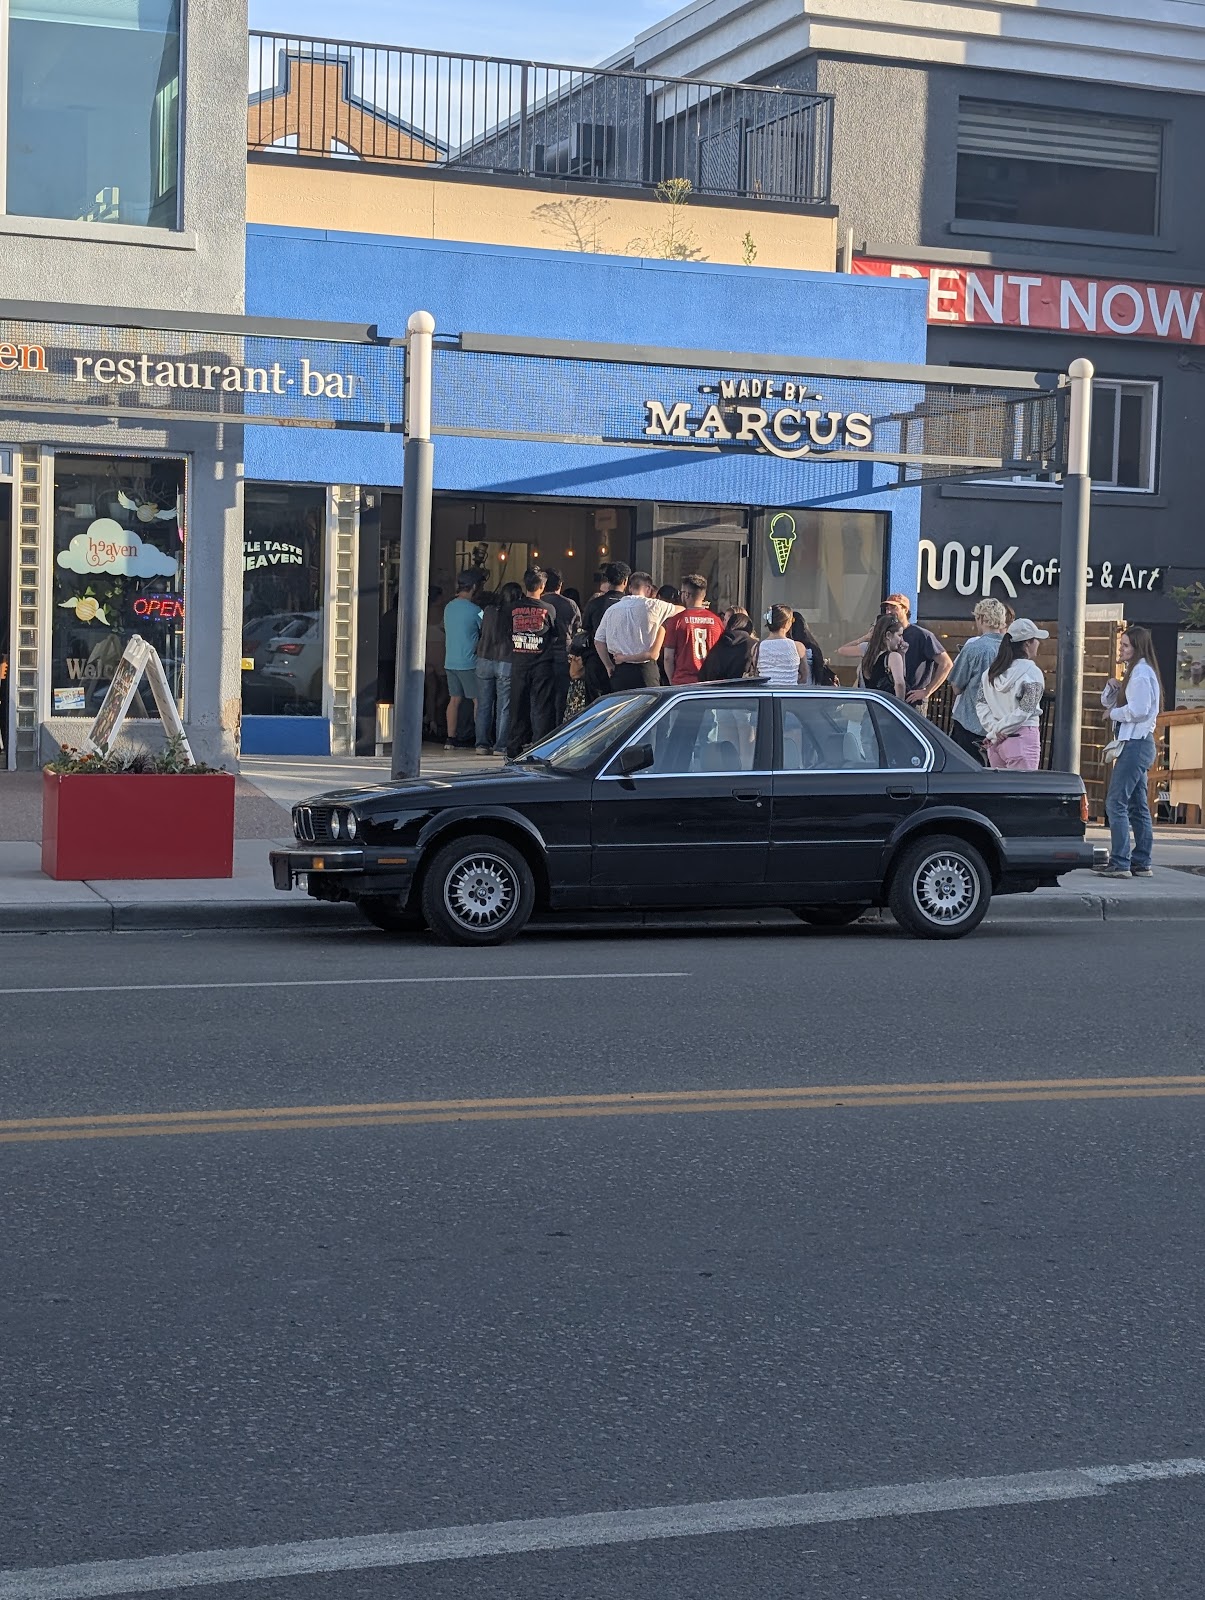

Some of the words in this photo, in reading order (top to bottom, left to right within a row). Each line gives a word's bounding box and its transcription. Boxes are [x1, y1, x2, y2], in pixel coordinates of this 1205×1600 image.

[890, 265, 1041, 326] ENT
[1059, 279, 1203, 340] NOW
[0, 342, 49, 372] en
[721, 379, 774, 399] MADE
[785, 382, 807, 404] BY
[645, 401, 873, 459] MARCUS
[264, 540, 303, 556] TASTE
[1020, 558, 1094, 587] Cofe
[1100, 561, 1113, 588] &
[1118, 563, 1160, 592] Art
[133, 598, 185, 617] OPEN
[694, 627, 708, 660] 8
[66, 658, 117, 680] Welc
